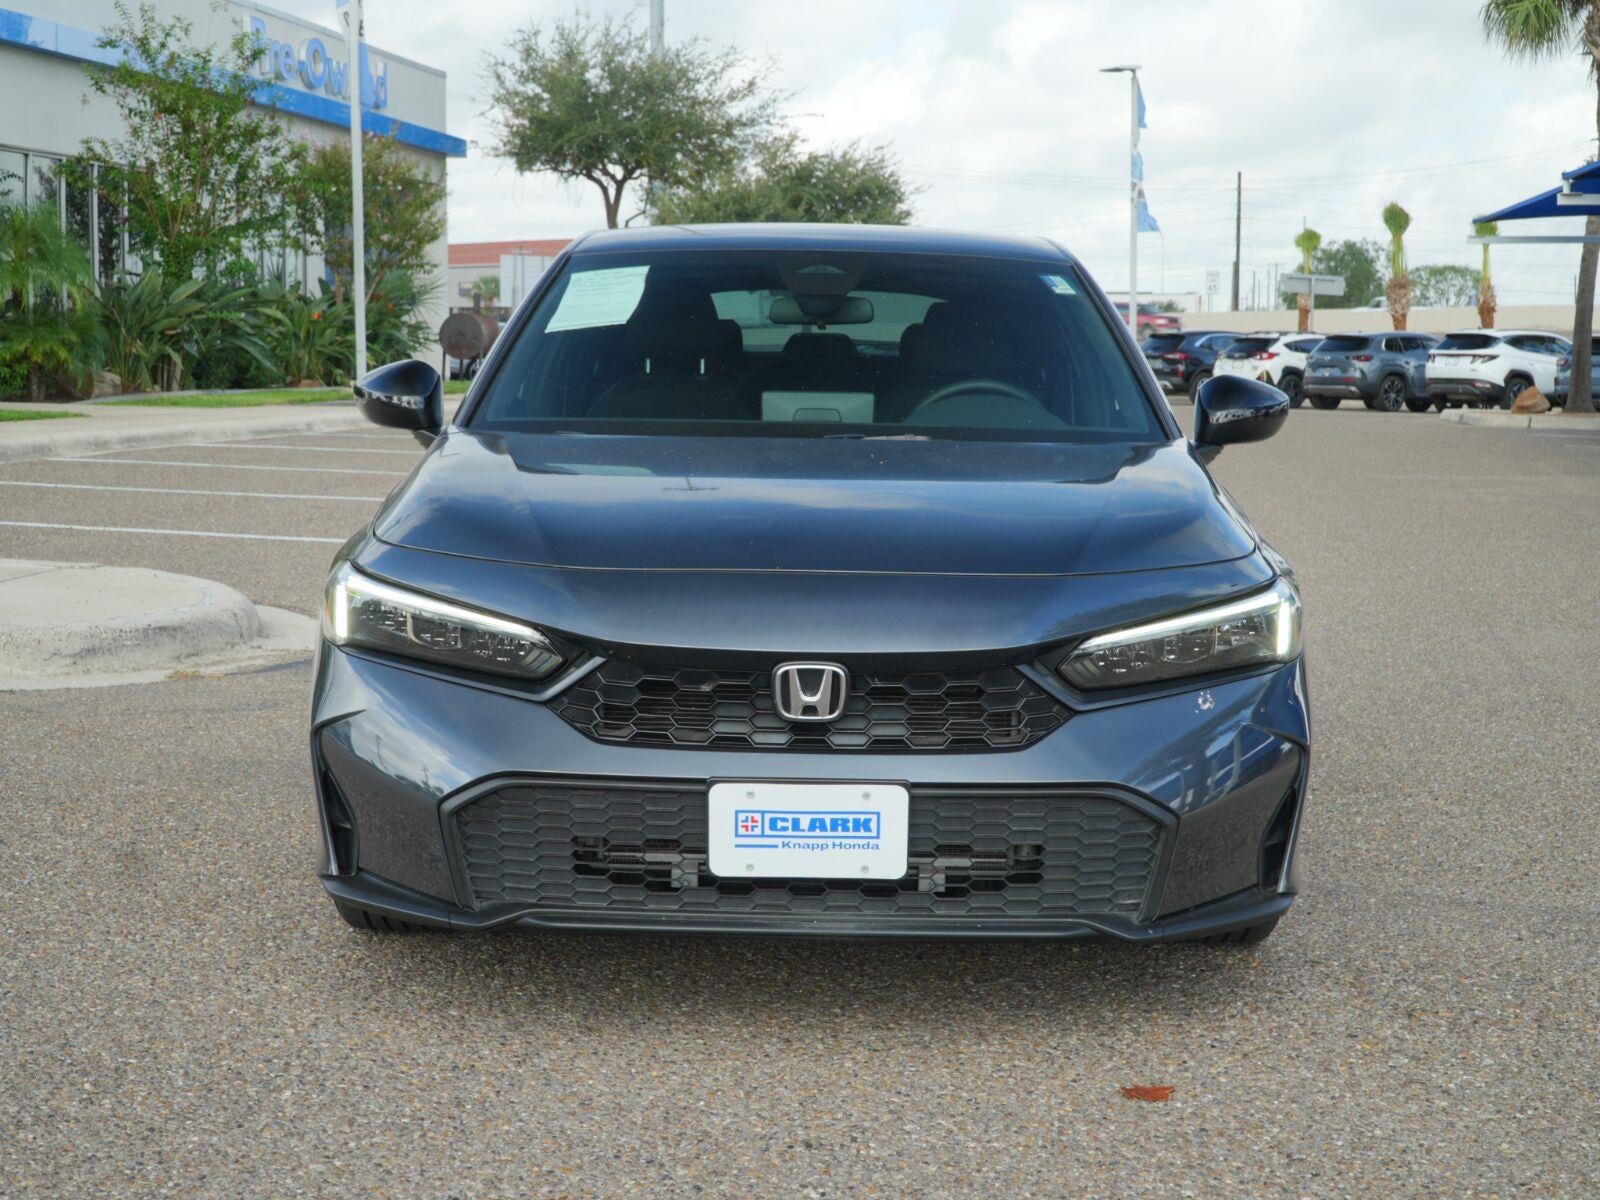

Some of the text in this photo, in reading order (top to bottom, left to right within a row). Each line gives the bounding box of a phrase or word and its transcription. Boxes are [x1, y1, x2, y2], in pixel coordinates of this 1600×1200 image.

[249, 16, 388, 109] Pre-Owd
[768, 816, 874, 833] CLARK
[781, 840, 880, 852] Knapp Honda
